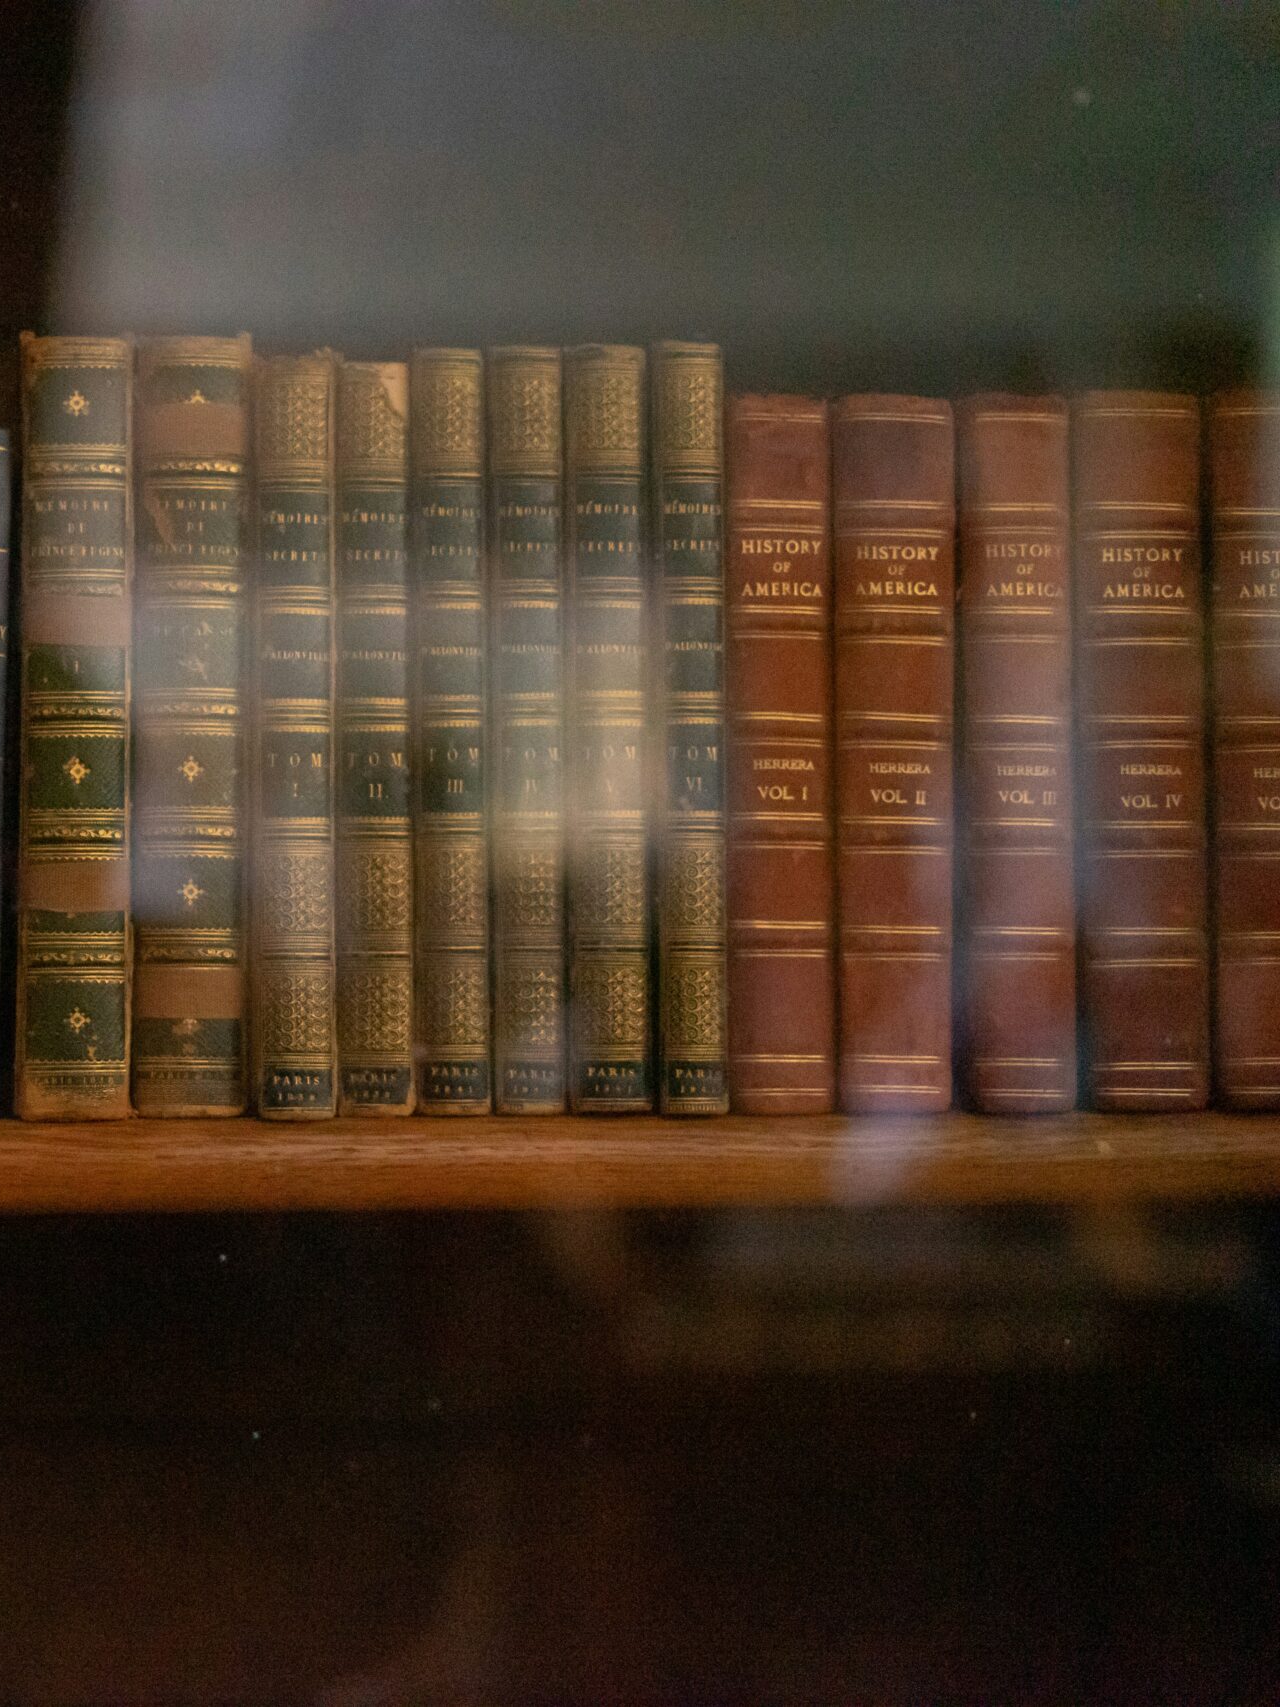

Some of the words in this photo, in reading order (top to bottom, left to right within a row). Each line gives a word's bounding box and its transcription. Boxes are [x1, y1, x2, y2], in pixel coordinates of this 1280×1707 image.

[741, 539, 821, 555] HISTORY
[856, 546, 939, 561] HISTORY
[985, 543, 1061, 558] HISTORY
[1102, 548, 1183, 563] HISTORY
[772, 561, 791, 573] OF
[888, 565, 907, 576] OF
[1017, 563, 1034, 575] OF
[1133, 567, 1151, 578] OF
[741, 582, 823, 597] AMERICA
[856, 581, 938, 596] AMERICA
[986, 582, 1063, 598] AMERICA
[1103, 584, 1184, 598] AMERICA
[753, 759, 815, 770] HERRERA
[870, 762, 931, 774] HERRERA
[997, 765, 1057, 777] HERRERA
[1120, 764, 1182, 776] HERRERA
[802, 785, 808, 800] I
[915, 790, 927, 806] II
[1042, 791, 1057, 806] III
[1166, 794, 1183, 808] IV
[350, 1072, 397, 1085] PARIS
[431, 1066, 479, 1078] PARIS
[508, 1068, 554, 1080] PARIS
[586, 1066, 635, 1079] PARIS
[675, 1068, 723, 1080] PARIS
[272, 1074, 320, 1086] PARIS
